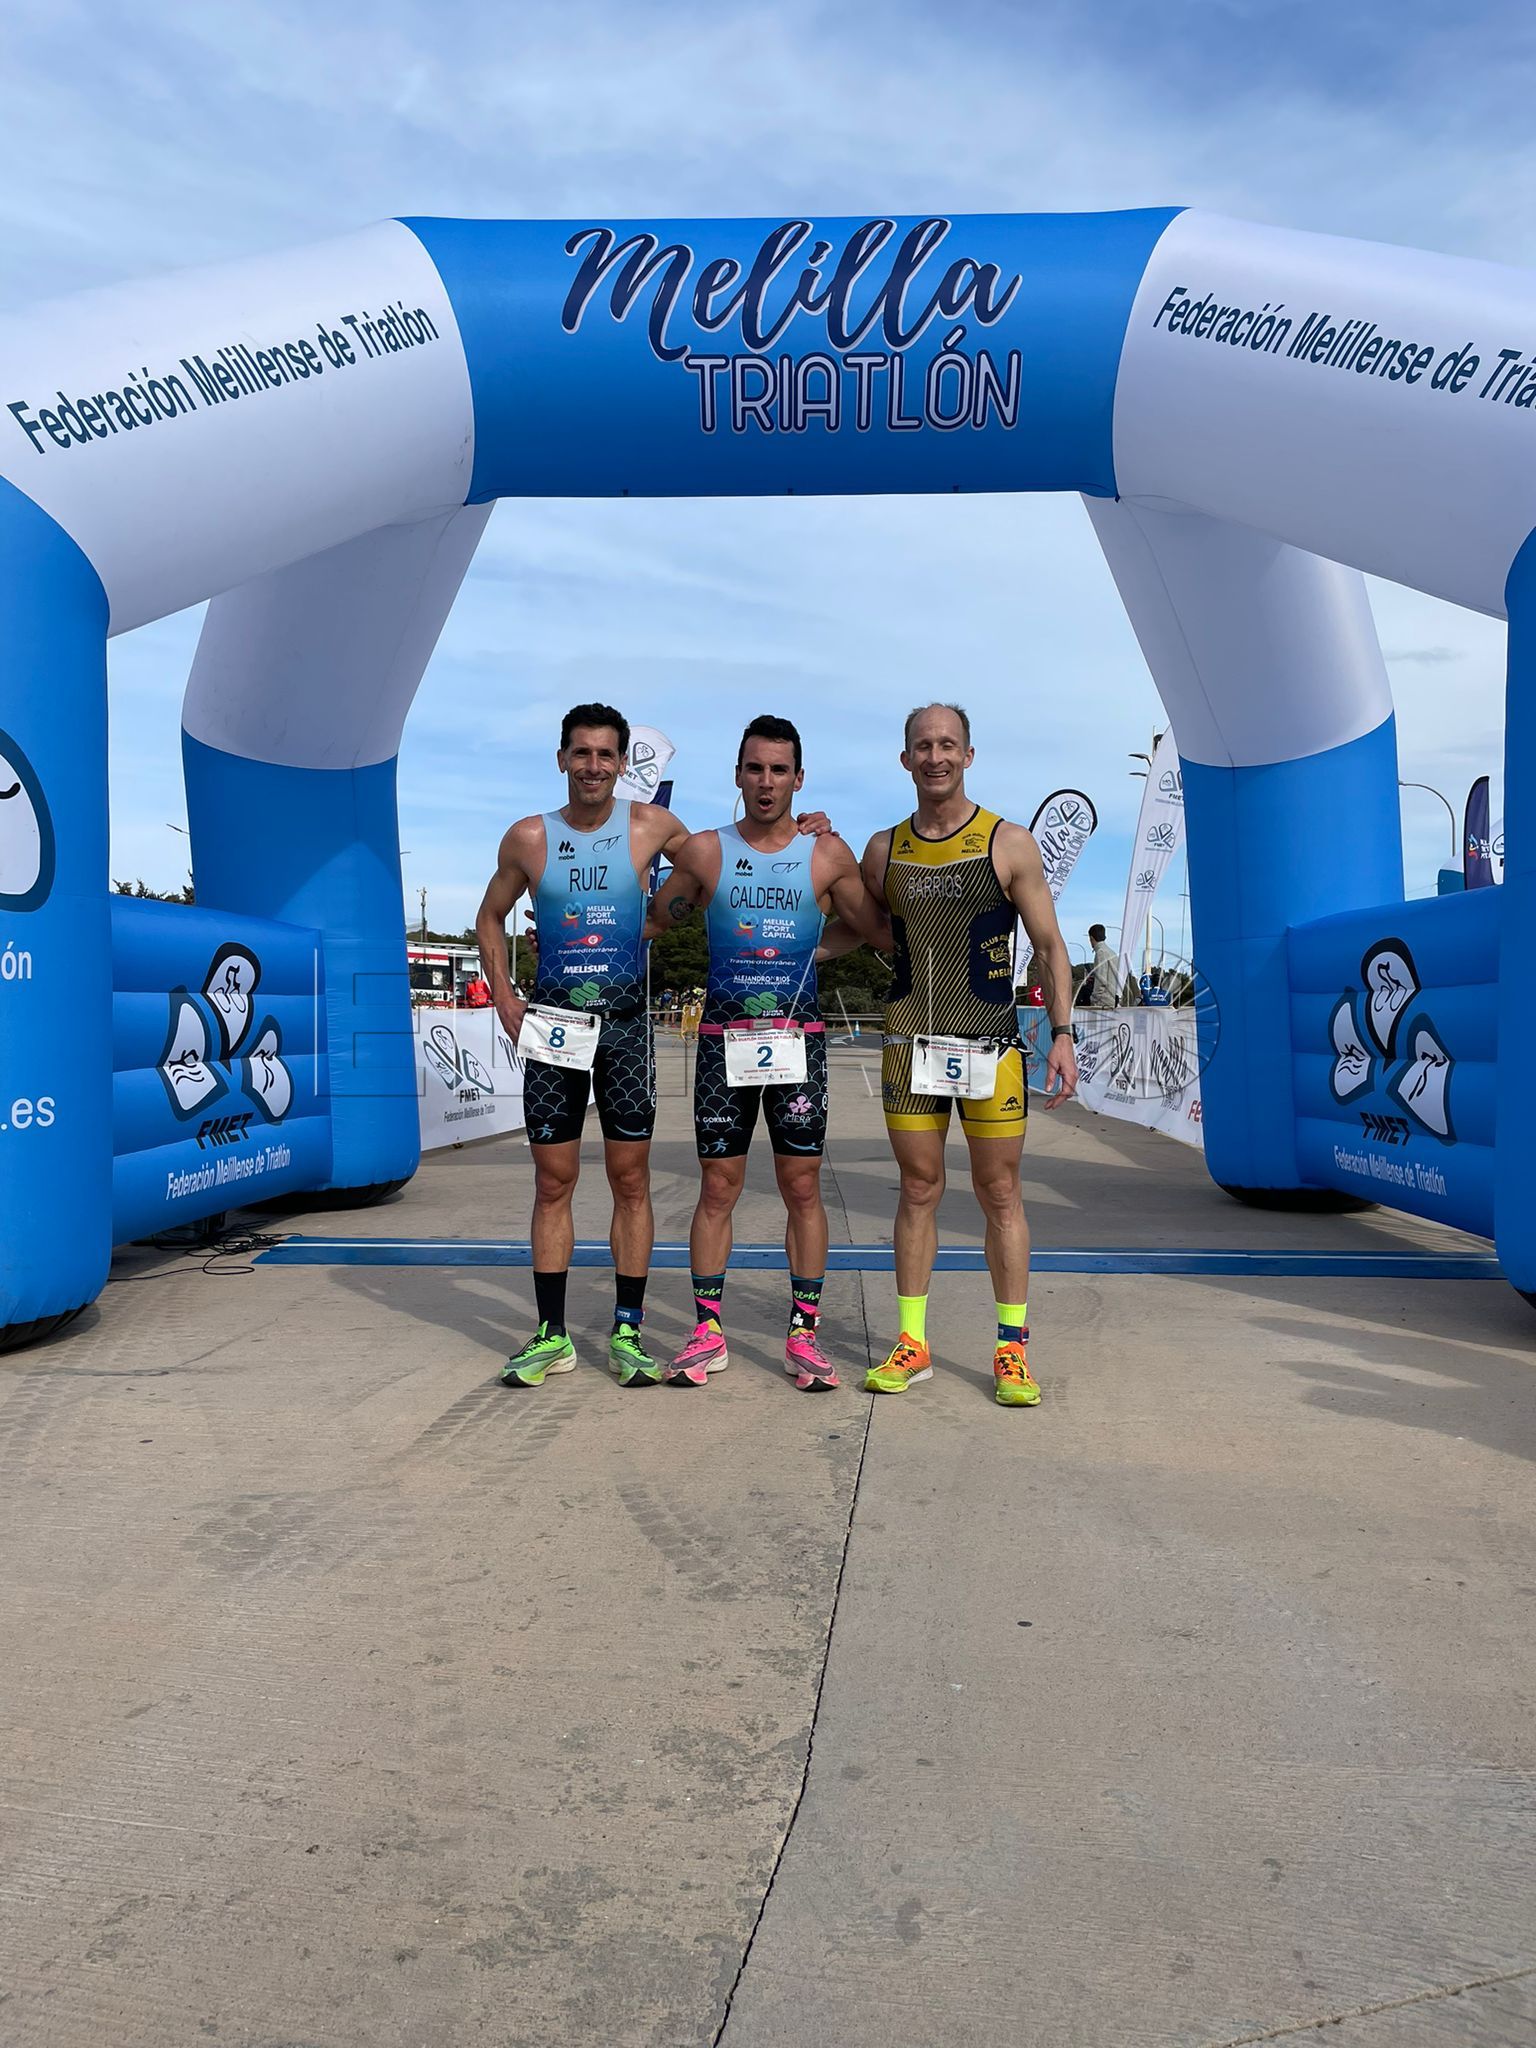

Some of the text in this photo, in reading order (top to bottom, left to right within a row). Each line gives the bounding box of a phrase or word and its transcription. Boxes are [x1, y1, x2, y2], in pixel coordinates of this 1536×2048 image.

[562, 218, 1022, 362] Melilla
[1153, 286, 1536, 408] Federación Melillense de Tria
[9, 301, 440, 455] Federación Melillense de Triatlón
[684, 325, 1022, 433] TRIATLÓN
[569, 865, 608, 892] RUIZ
[908, 874, 963, 899] BARRIOS
[730, 886, 802, 911] CALDERAY
[762, 918, 796, 927] MELILLA
[762, 931, 796, 939] CAPITAL
[563, 964, 609, 974] MELISUR
[549, 1026, 566, 1048] 8
[757, 1045, 773, 1068] 2
[945, 1057, 963, 1080] 5
[460, 1087, 480, 1103] FMET
[195, 1112, 254, 1150] FMET
[1360, 1111, 1411, 1147] FMET
[166, 1143, 291, 1200] Federación Melillense de Triatlón
[1333, 1145, 1448, 1196] Federación Melillense de Triatlón
